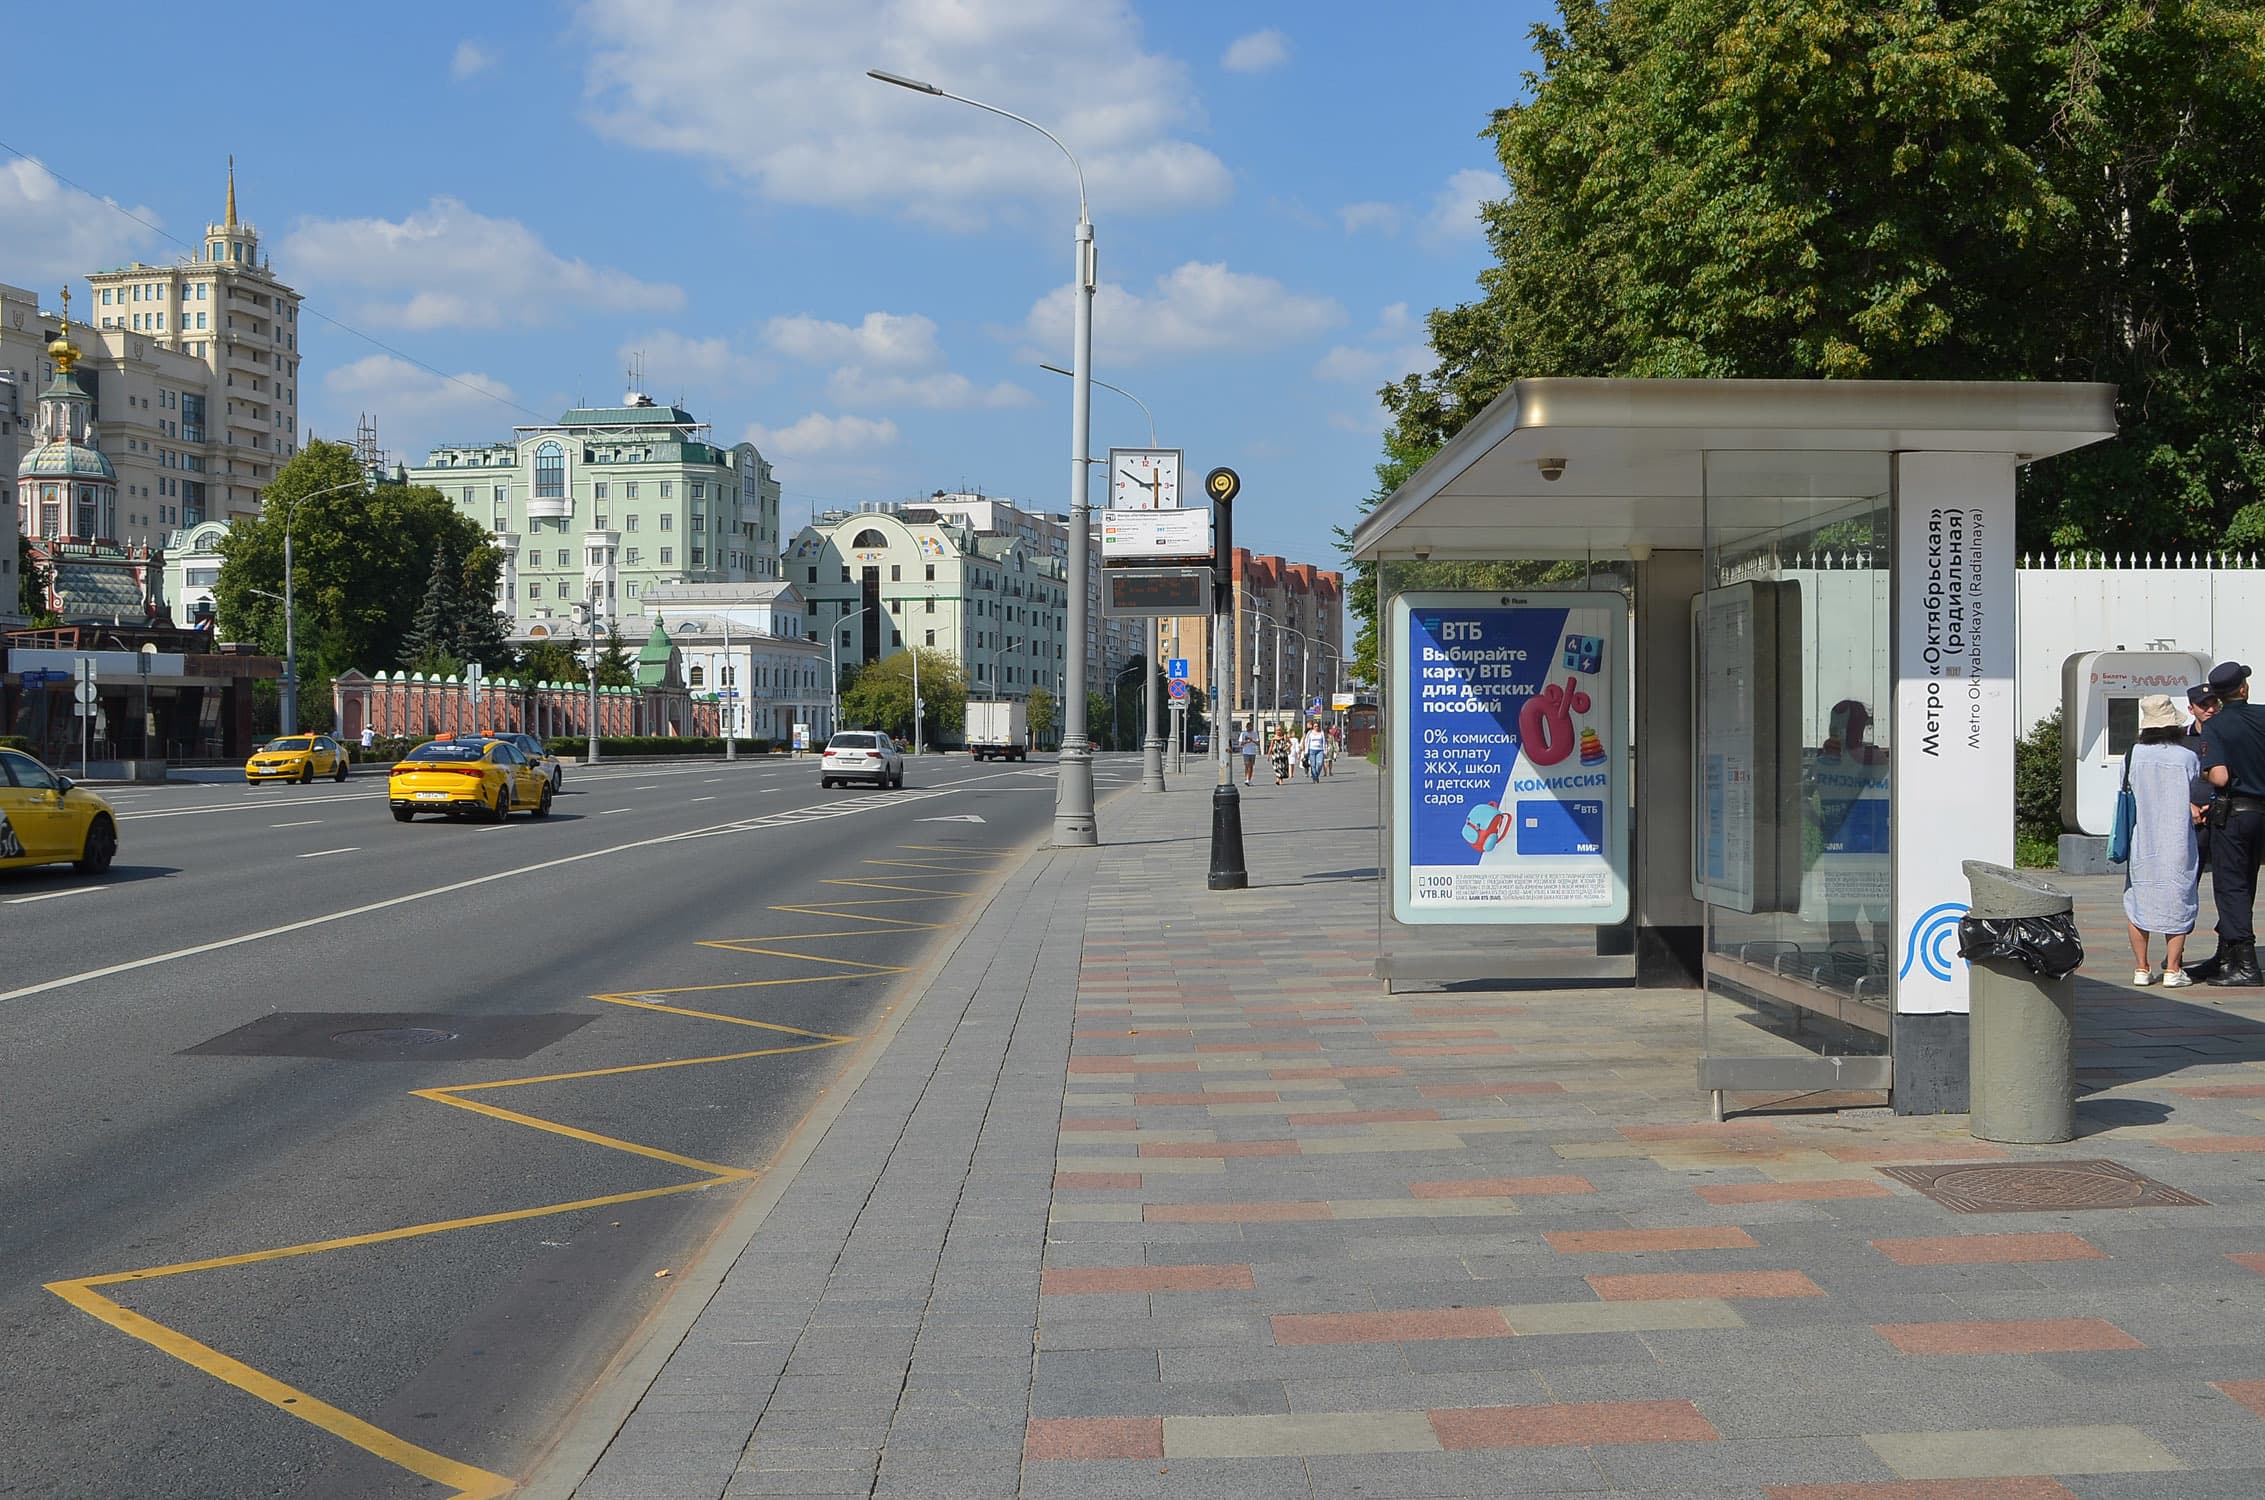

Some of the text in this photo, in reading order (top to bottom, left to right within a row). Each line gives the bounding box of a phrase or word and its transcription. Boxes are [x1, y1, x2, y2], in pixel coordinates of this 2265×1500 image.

[1943, 508, 1965, 655] (радиальная)
[1442, 622, 1482, 640] ВТБ
[1922, 508, 1945, 757] Метро «Октябрьская»
[1968, 508, 1984, 749] Metro Oktyabrskaya (Radialnaya)
[1422, 646, 1528, 664] Выбирайте
[1423, 664, 1512, 682] карту ВТБ
[1422, 684, 1534, 698] для детских
[1423, 698, 1502, 712] пособий
[1424, 729, 1517, 744] 0% комиссия
[1424, 749, 1491, 761] за оплату
[1424, 762, 1500, 775] ЖКХ, школ
[1424, 779, 1490, 790] и детских
[1514, 774, 1606, 792] КОМИССИЯ
[1424, 795, 1464, 806] садов
[1577, 844, 1599, 852] МИР
[1427, 877, 1452, 886] 1000
[1420, 890, 1452, 898] VTB.RU
